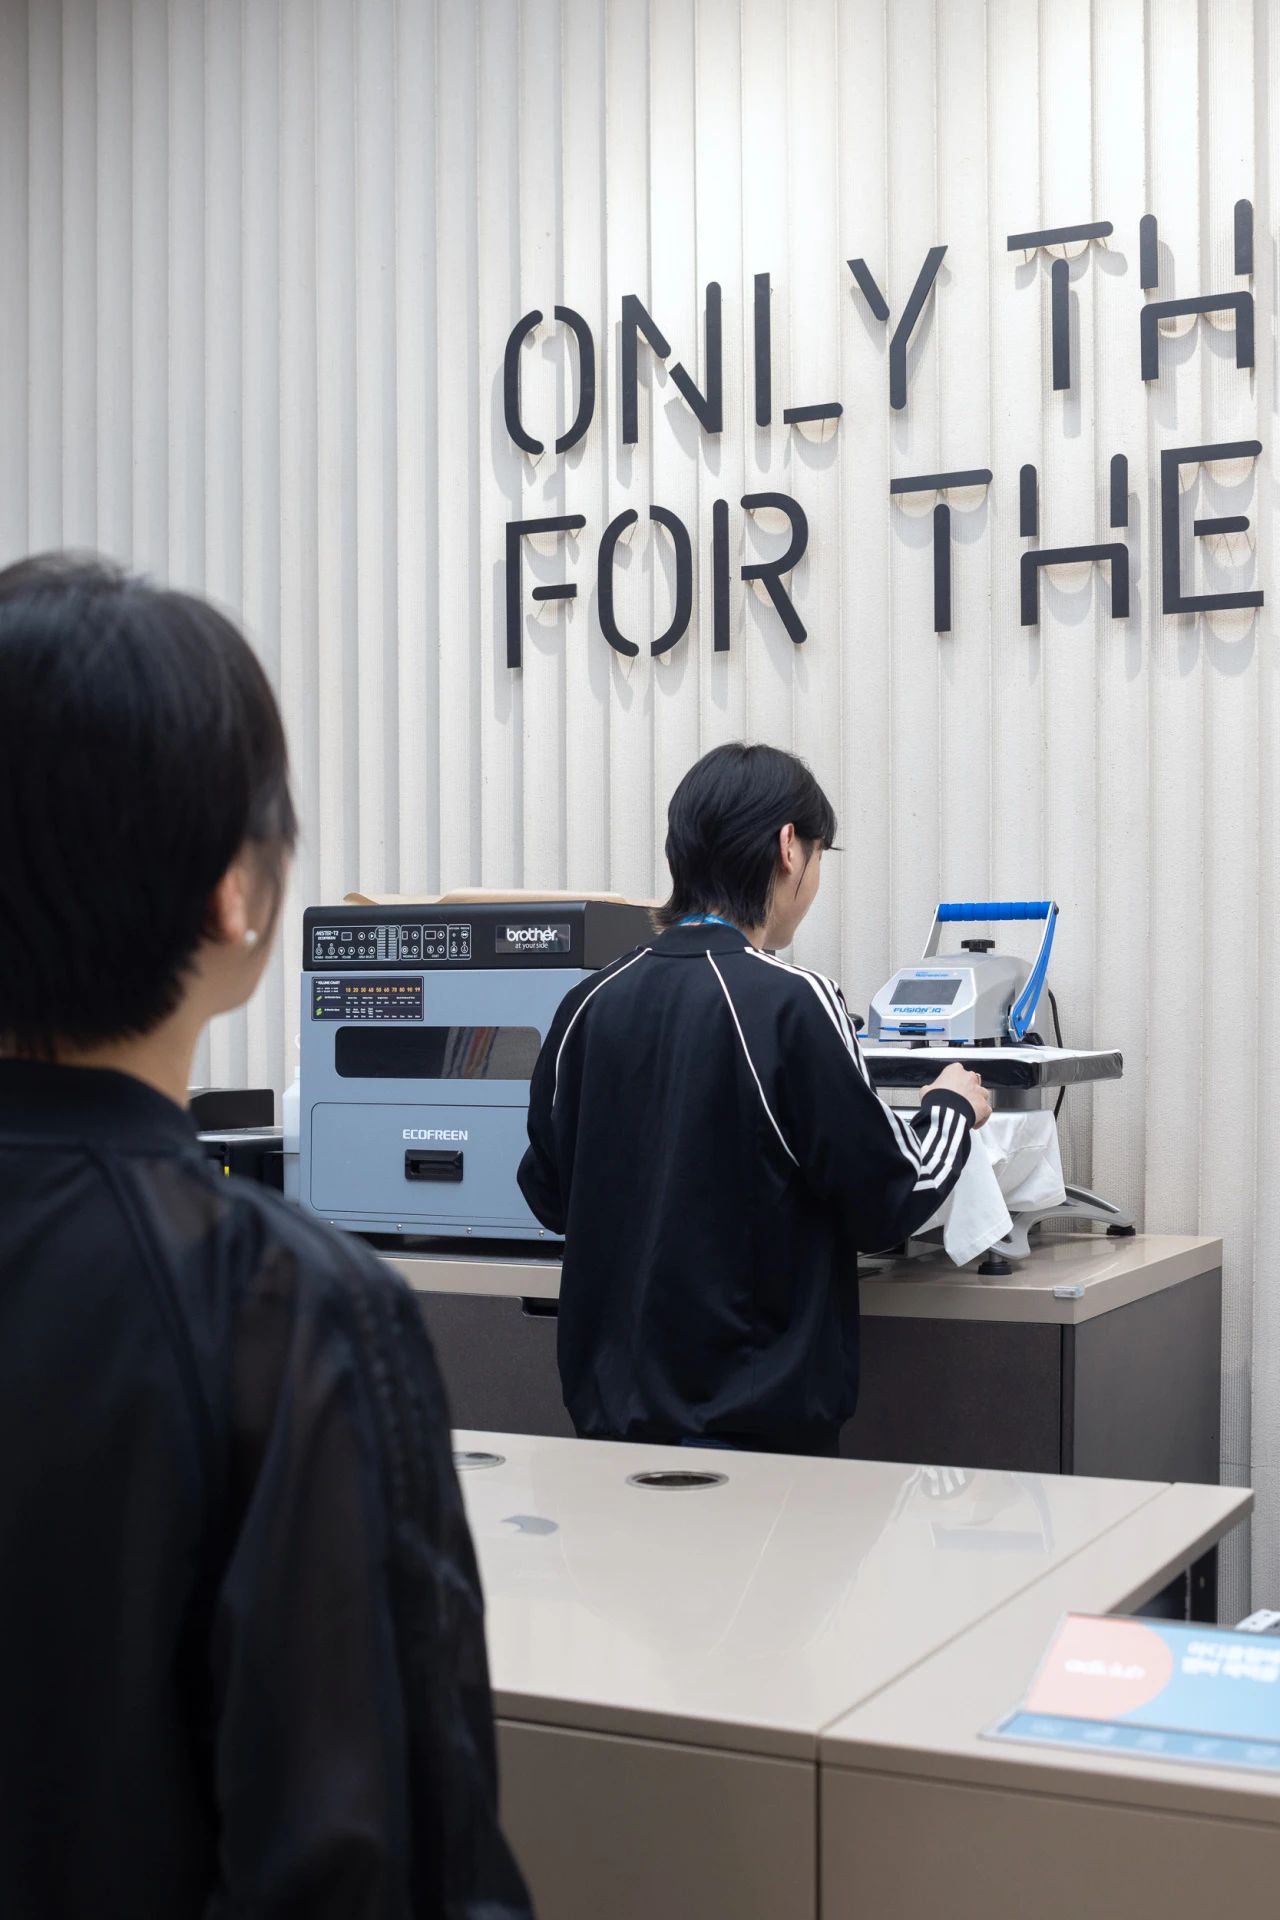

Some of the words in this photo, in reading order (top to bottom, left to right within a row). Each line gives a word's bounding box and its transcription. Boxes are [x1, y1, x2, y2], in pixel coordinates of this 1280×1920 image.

[503, 244, 948, 455] ONLY
[1007, 199, 1255, 391] TH
[506, 491, 809, 668] FOR
[890, 440, 1264, 632] THE
[506, 927, 557, 941] brother
[402, 1128, 468, 1141] ECOFREEN
